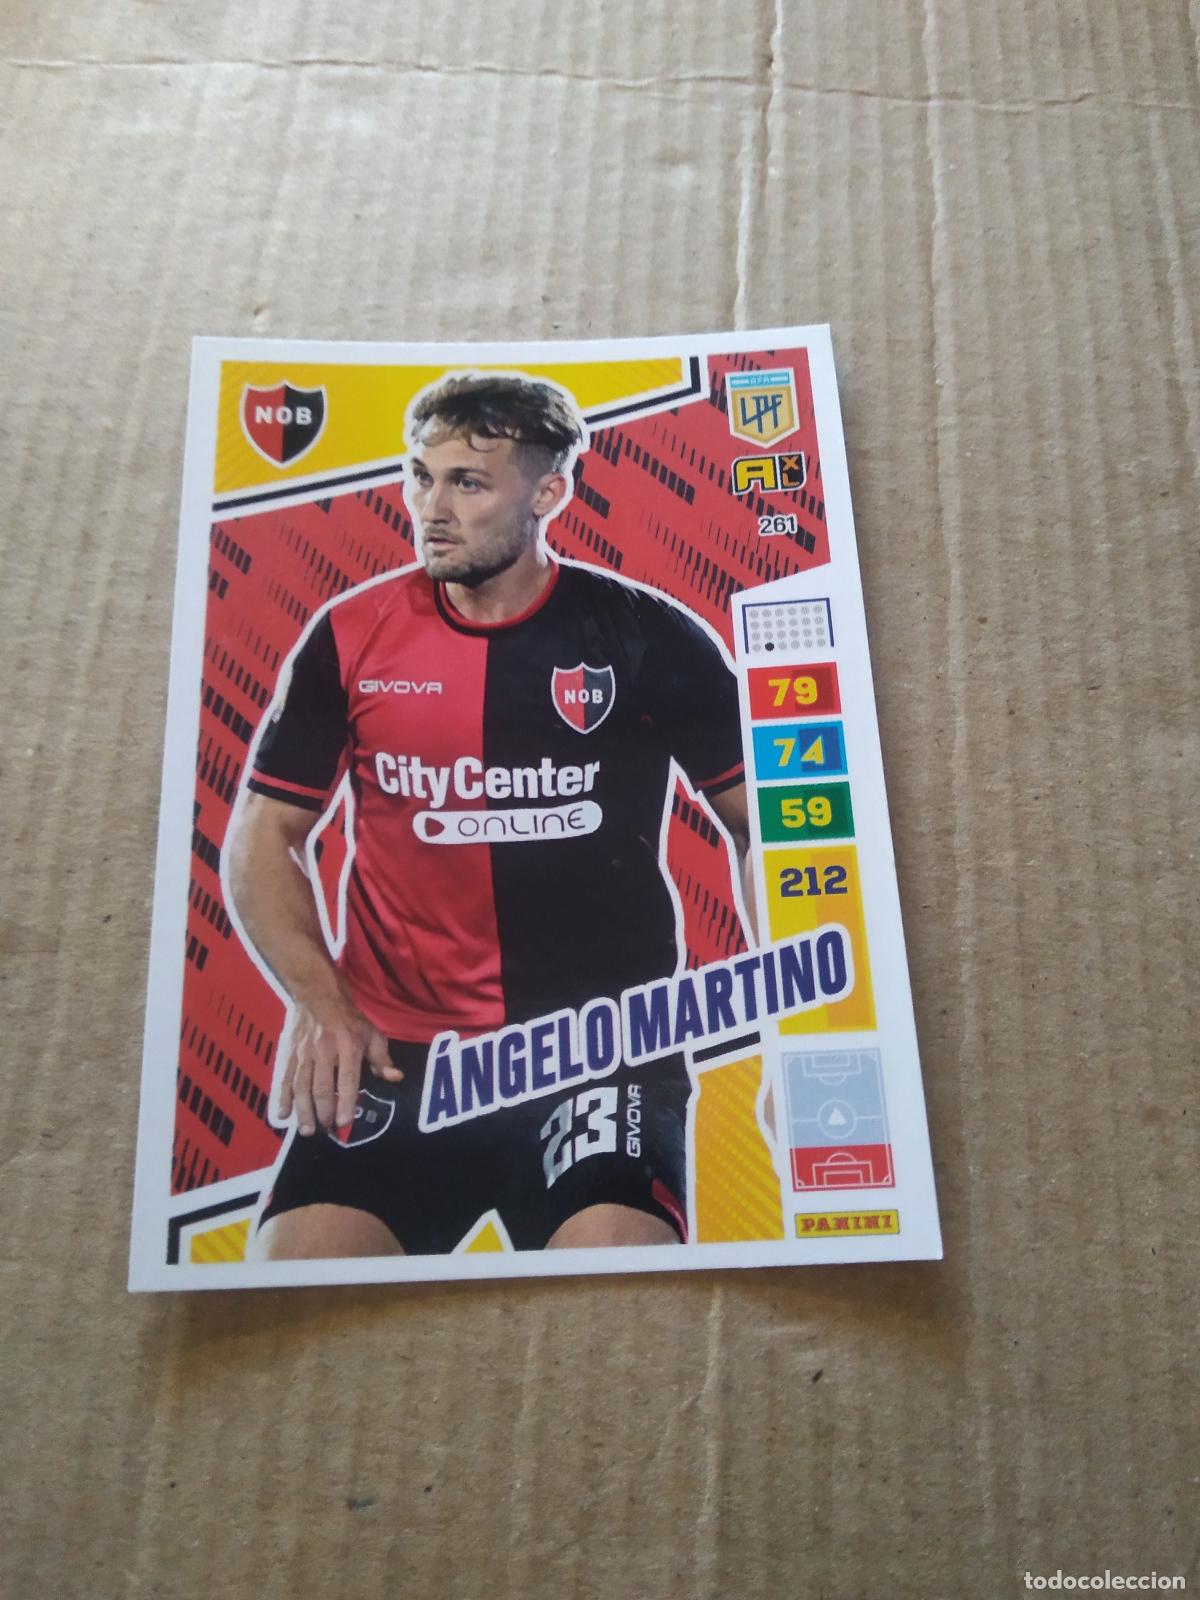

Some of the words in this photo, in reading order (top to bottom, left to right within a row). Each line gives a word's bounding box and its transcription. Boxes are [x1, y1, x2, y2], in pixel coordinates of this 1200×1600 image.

[255, 406, 312, 425] NOB
[759, 515, 797, 535] 261
[358, 680, 443, 695] GIVOVA
[564, 689, 603, 704] NOB
[768, 676, 818, 706] 79
[773, 736, 825, 767] 74
[781, 796, 832, 828] 59
[780, 865, 848, 897] 212
[427, 1005, 617, 1125] ÁNGELO
[628, 930, 847, 1059] MARTINO
[626, 1083, 641, 1158] GIVOVA
[540, 1087, 618, 1189] 23
[800, 1215, 892, 1232] PANINI
